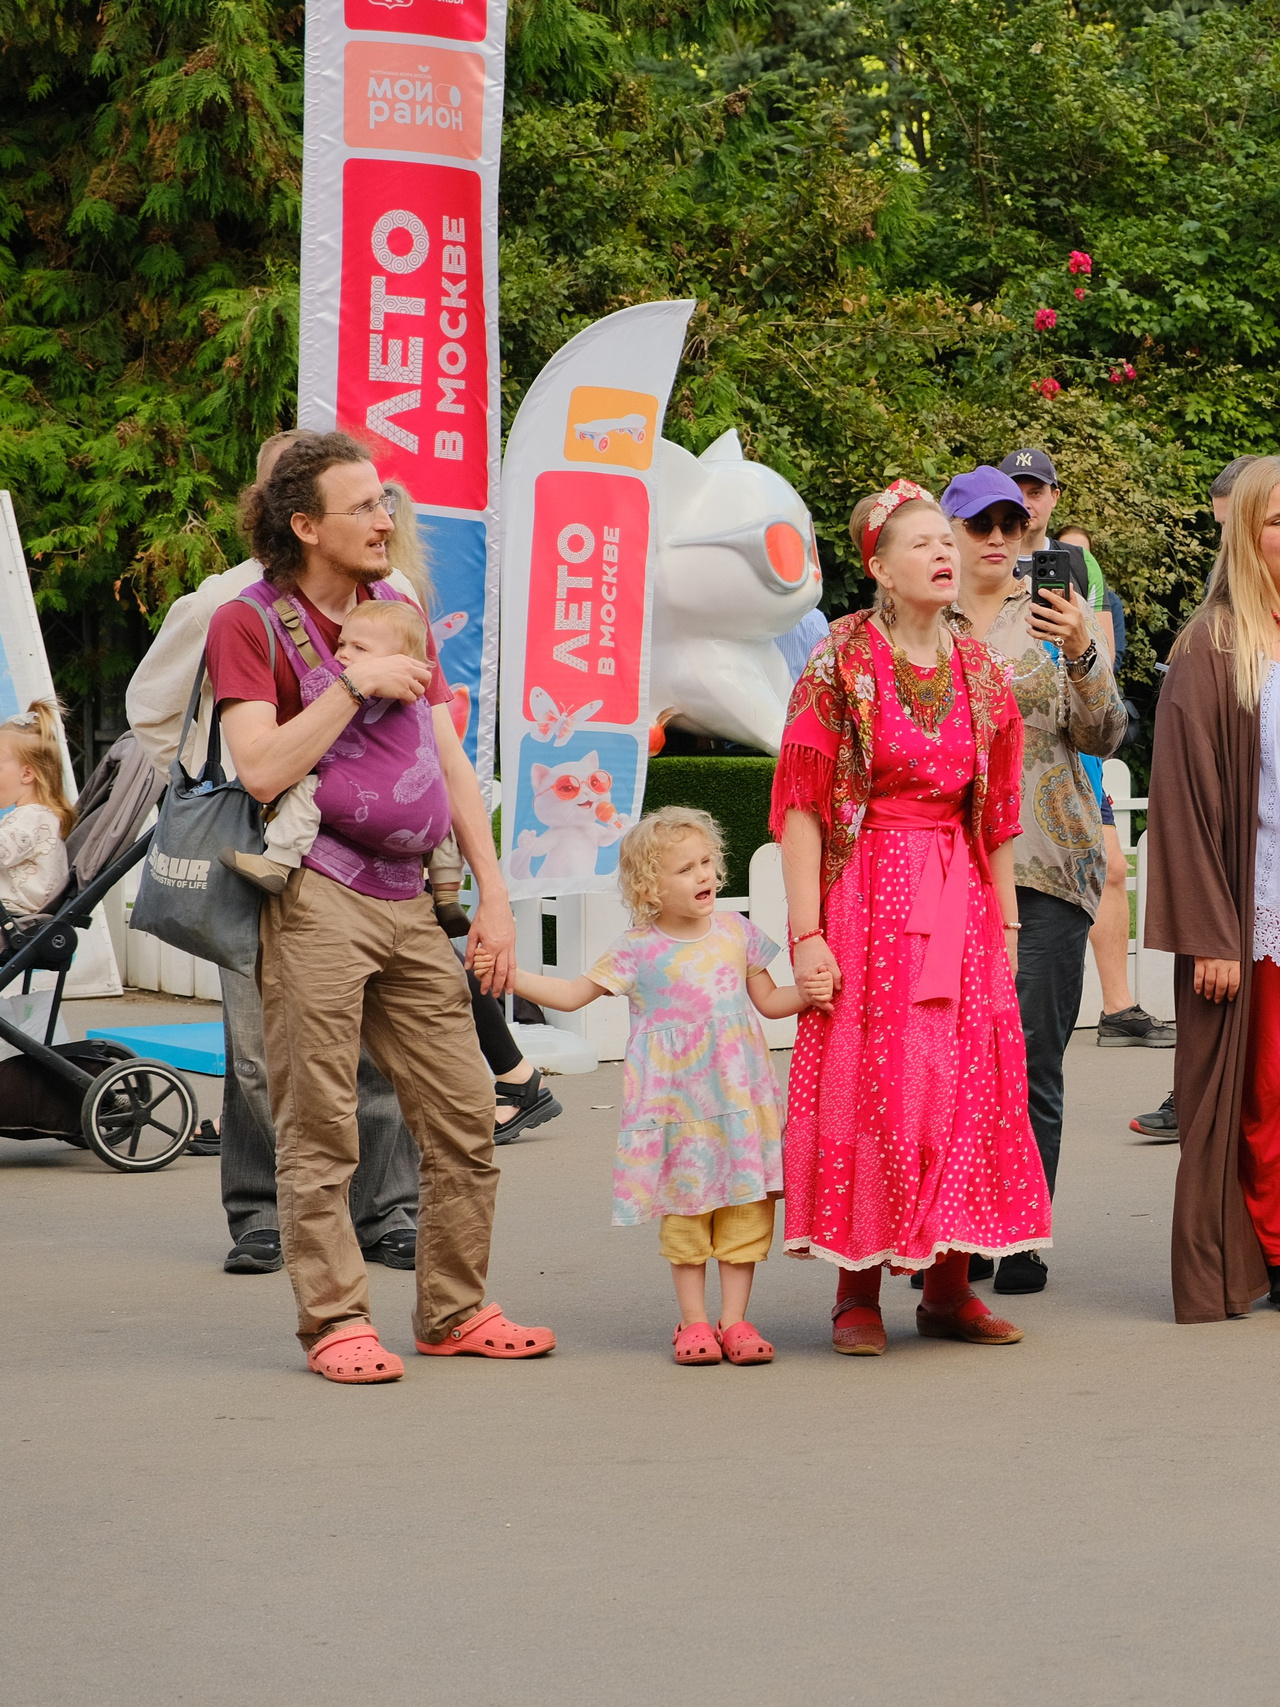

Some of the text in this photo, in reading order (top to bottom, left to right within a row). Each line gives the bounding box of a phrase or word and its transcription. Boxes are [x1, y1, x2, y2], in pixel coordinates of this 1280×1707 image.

[366, 209, 430, 455] ЛЕТО
[434, 215, 468, 461] В МОСКВЕ
[553, 523, 595, 673] ЛЕТО
[598, 526, 620, 676] В МОСКВЕ
[176, 880, 188, 889] OF
[189, 881, 208, 890] LIFE
